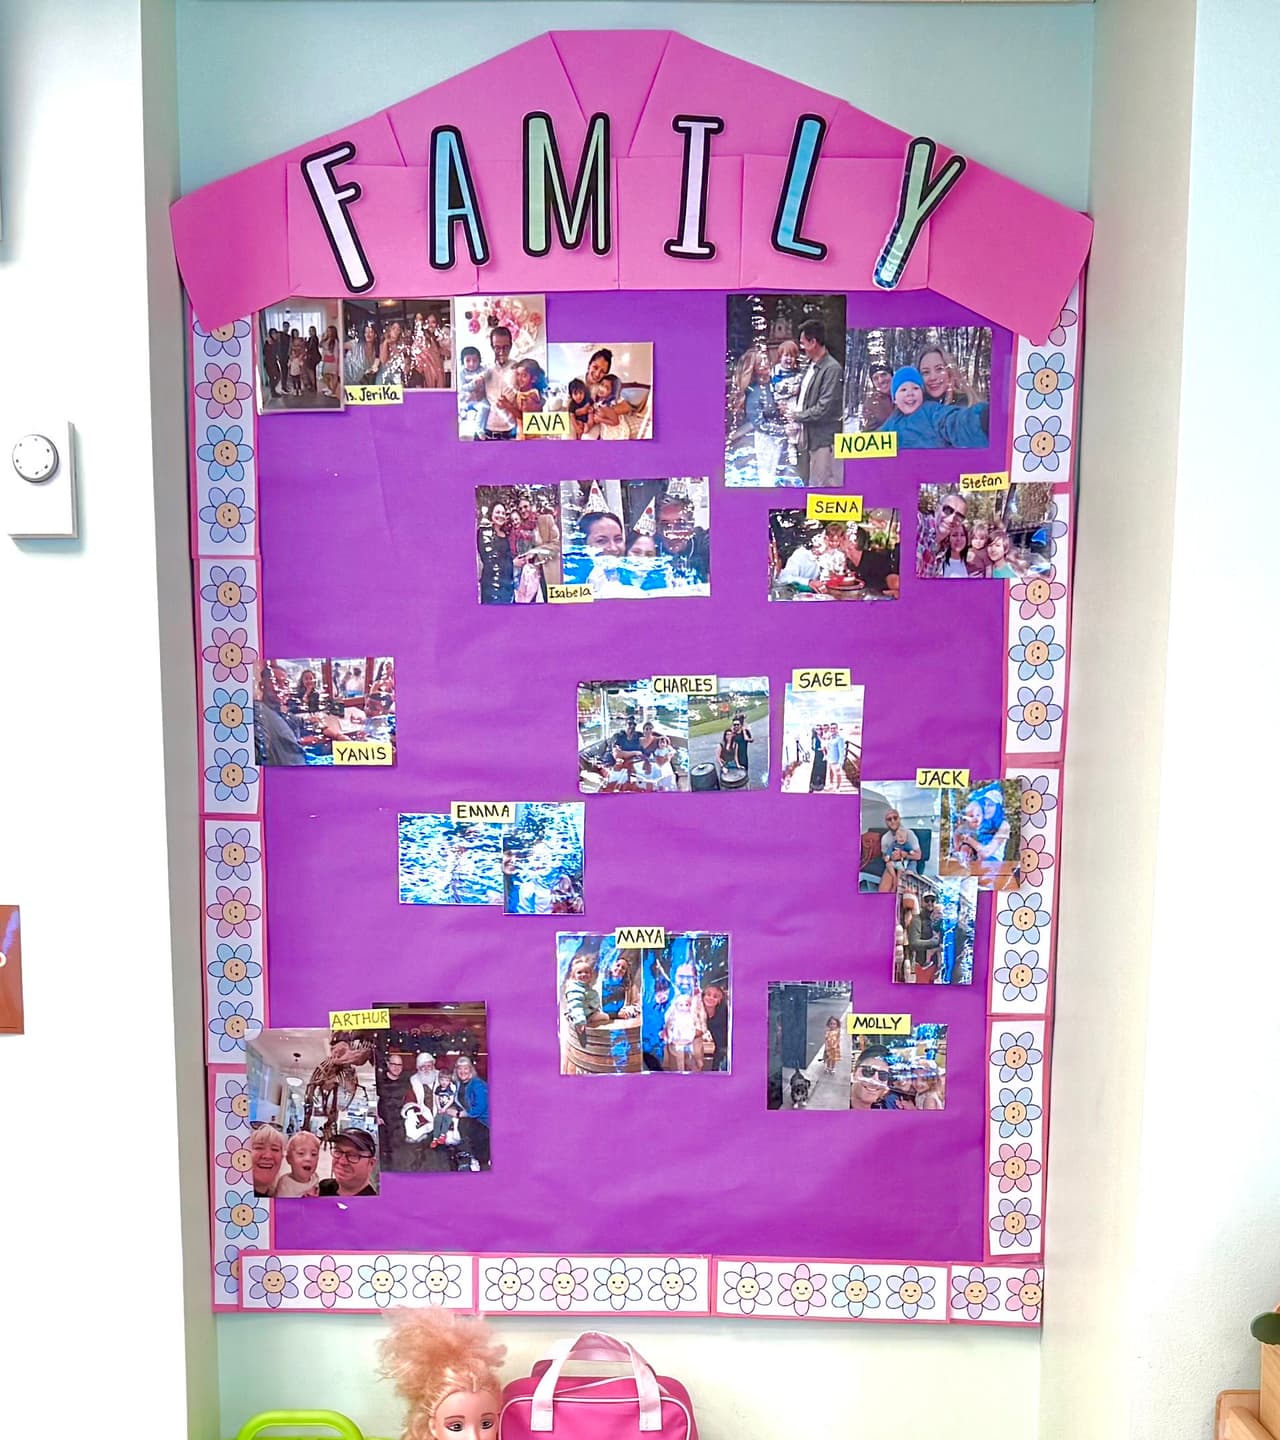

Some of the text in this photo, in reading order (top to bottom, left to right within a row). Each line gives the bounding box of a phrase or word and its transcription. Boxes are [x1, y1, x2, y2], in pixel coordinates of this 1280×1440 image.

[300, 111, 968, 294] FAMILY
[526, 413, 566, 432] AVA
[840, 433, 892, 453] NOAH
[961, 474, 1003, 489] Stefan
[814, 500, 859, 514] SENA
[548, 586, 592, 599] Isabela
[653, 677, 713, 693] CHARLES
[797, 671, 848, 688] SAGE
[335, 746, 387, 762] YANIS
[918, 770, 966, 788] JACK
[456, 804, 510, 819] EMMA
[616, 928, 663, 945] MAYA
[331, 1010, 388, 1028] ARTHUR
[852, 1016, 903, 1031] MOLLY
